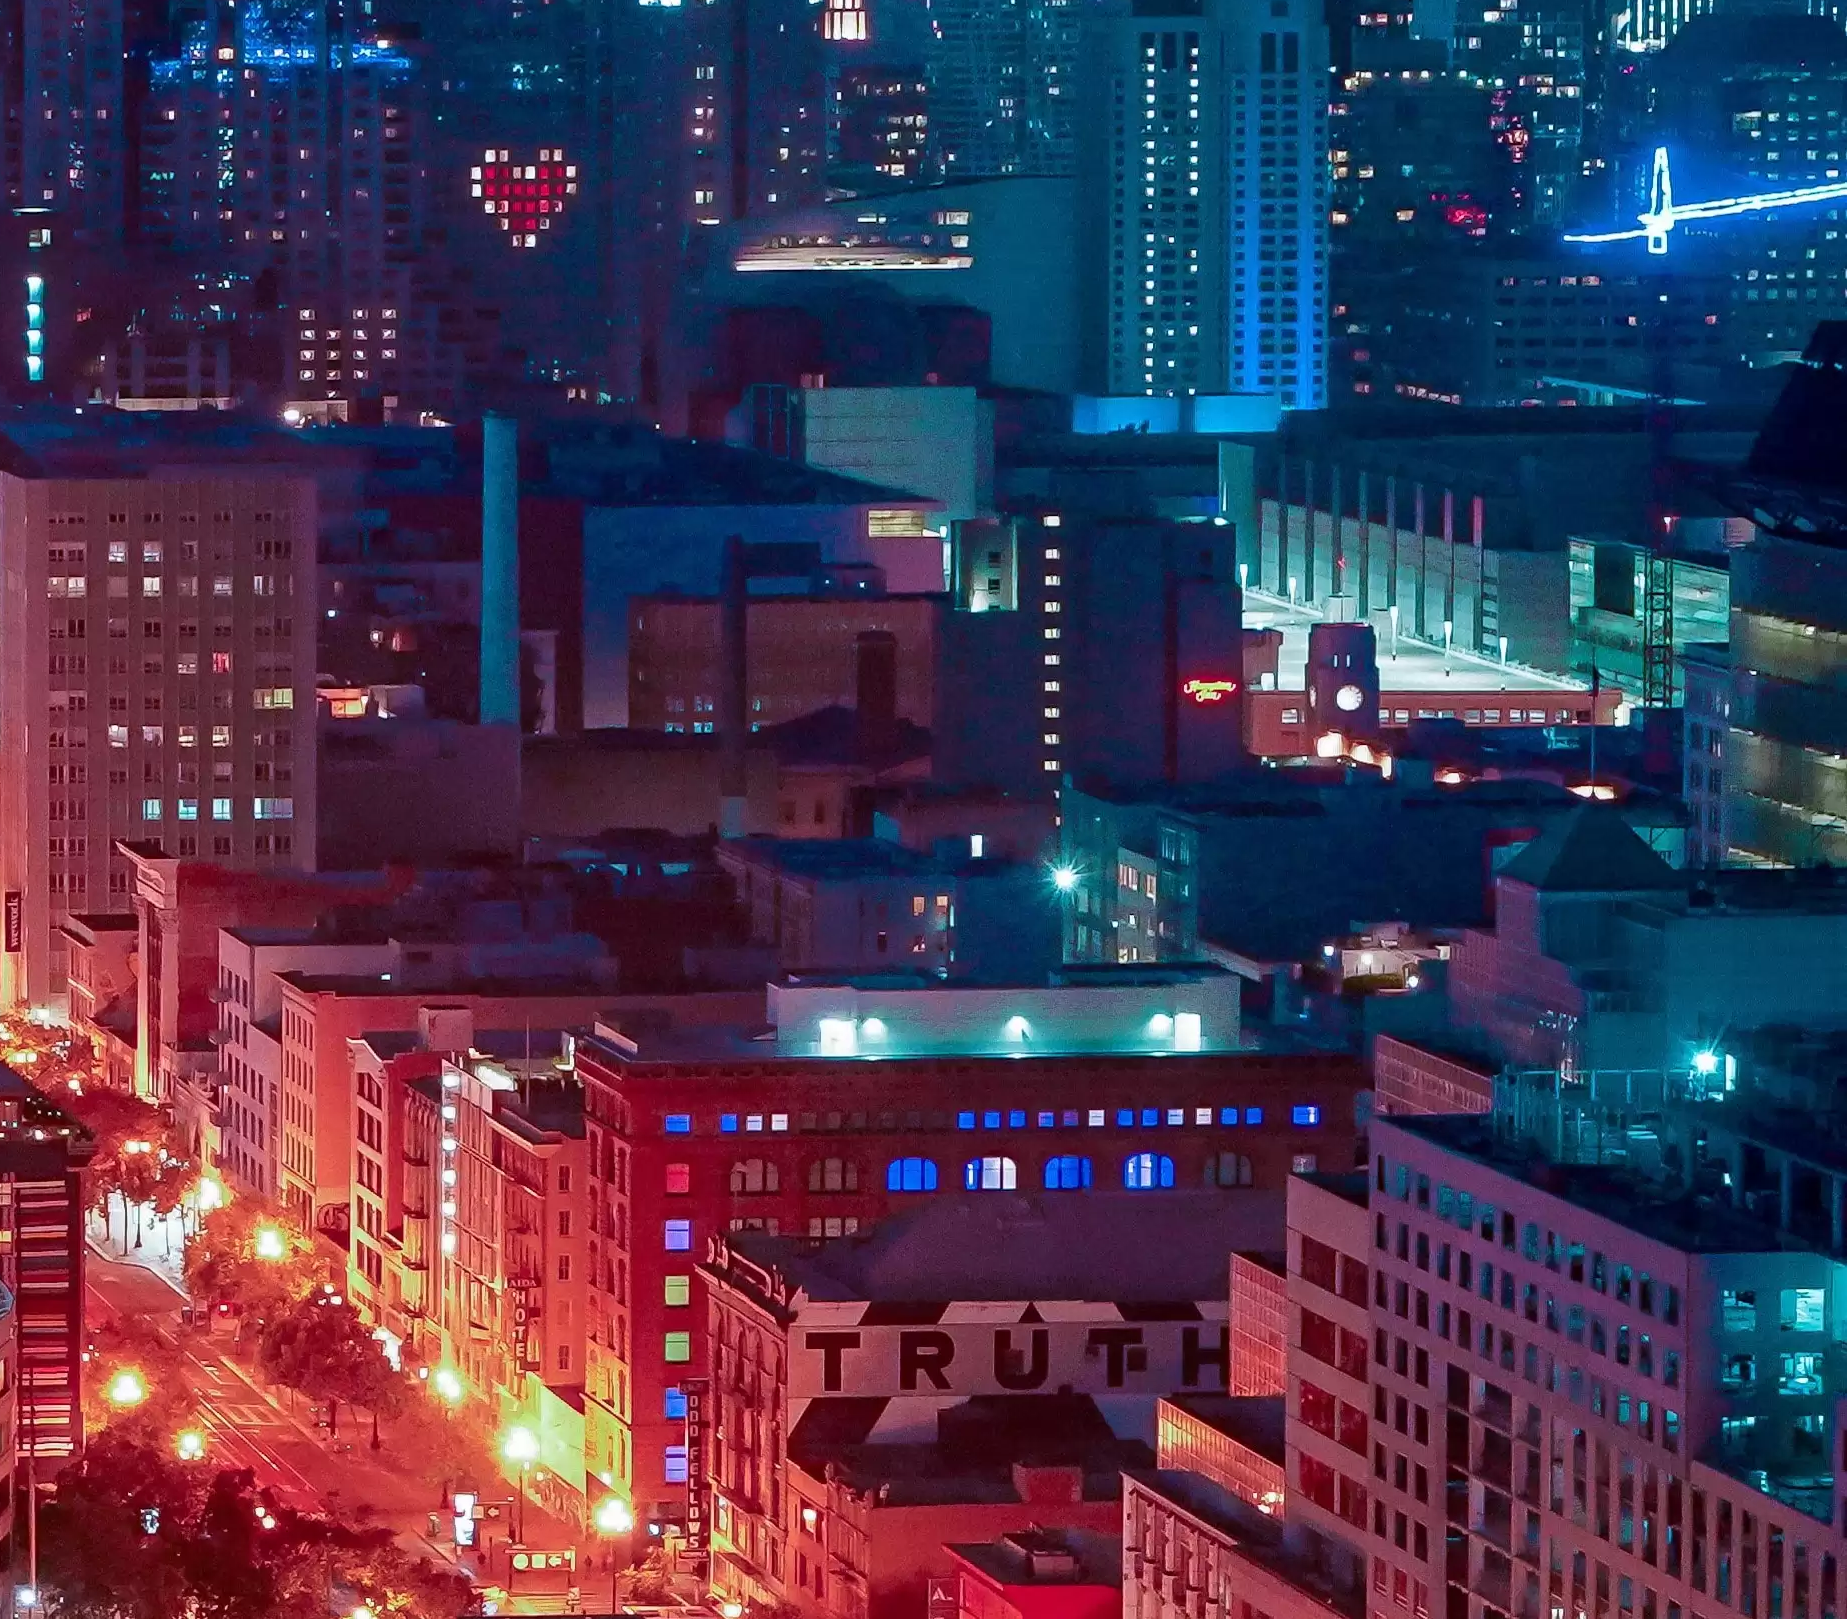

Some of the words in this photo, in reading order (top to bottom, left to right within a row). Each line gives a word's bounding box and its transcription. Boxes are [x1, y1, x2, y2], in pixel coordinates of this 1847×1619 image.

[508, 1279, 537, 1288] AIDA
[514, 1290, 527, 1374] HOTEL
[805, 1326, 1230, 1392] TRUTH
[689, 1395, 699, 1437] ODD
[688, 1446, 701, 1549] FELLOWS
